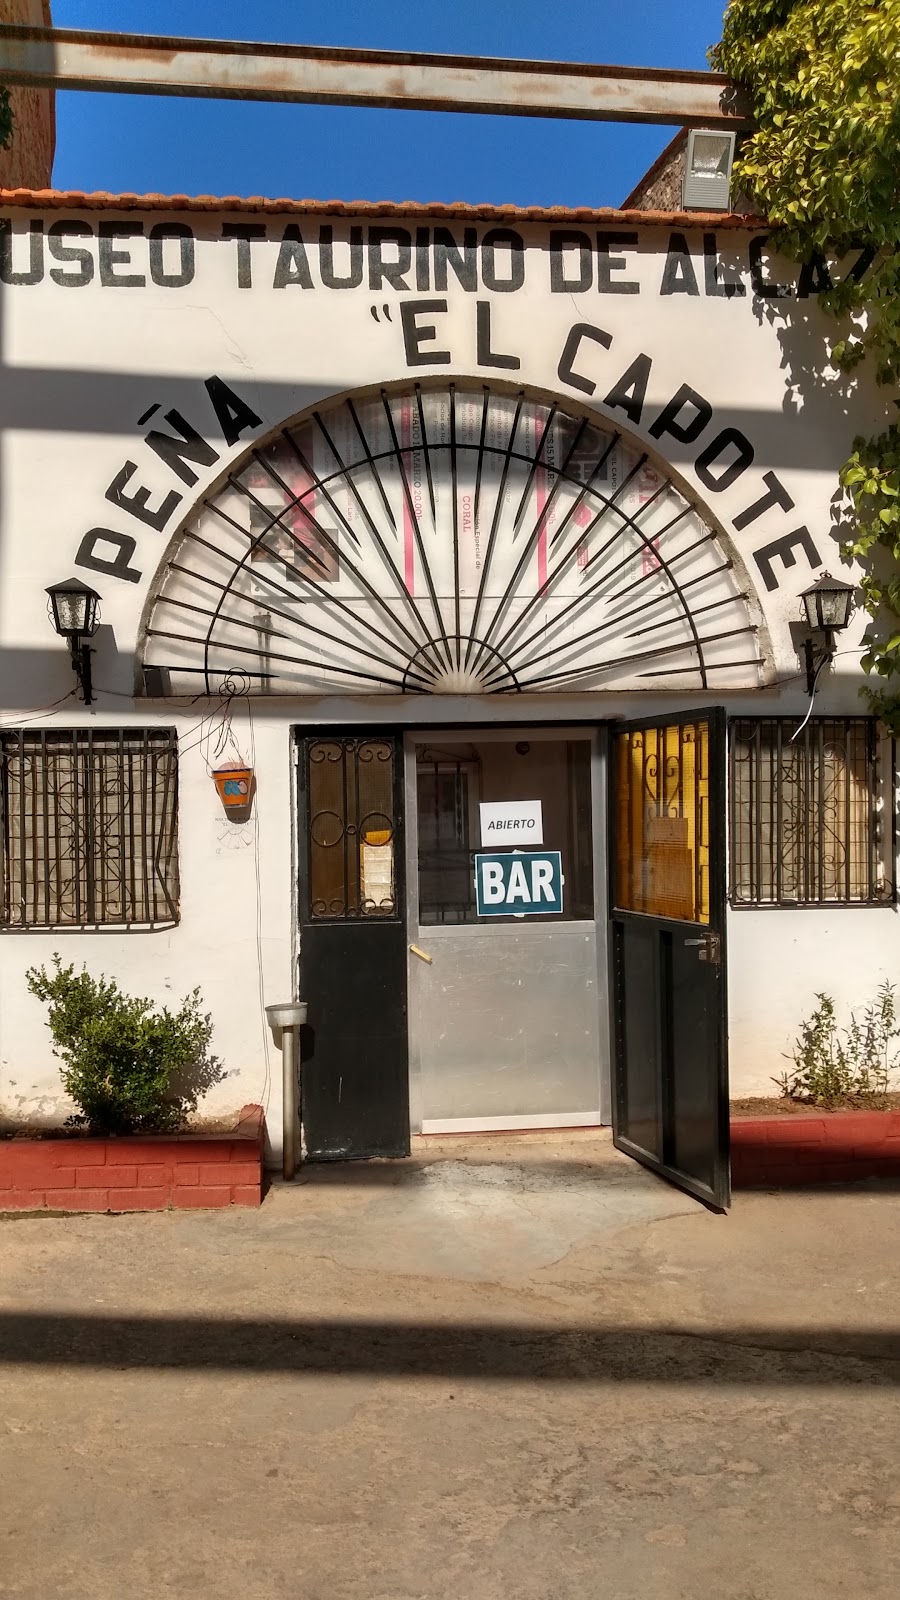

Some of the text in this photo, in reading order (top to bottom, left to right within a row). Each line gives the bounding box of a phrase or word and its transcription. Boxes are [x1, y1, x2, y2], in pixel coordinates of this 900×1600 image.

[222, 222, 525, 293] TAURINO
[550, 230, 641, 295] DE
[413, 452, 422, 489] MARZO
[557, 323, 823, 593] CAPOTE
[75, 375, 263, 584] PEÑA
[462, 495, 471, 532] CORAL
[473, 531, 482, 560] Especial
[474, 560, 482, 570] de
[487, 818, 536, 831] ABIERTO
[481, 860, 557, 905] BAR
